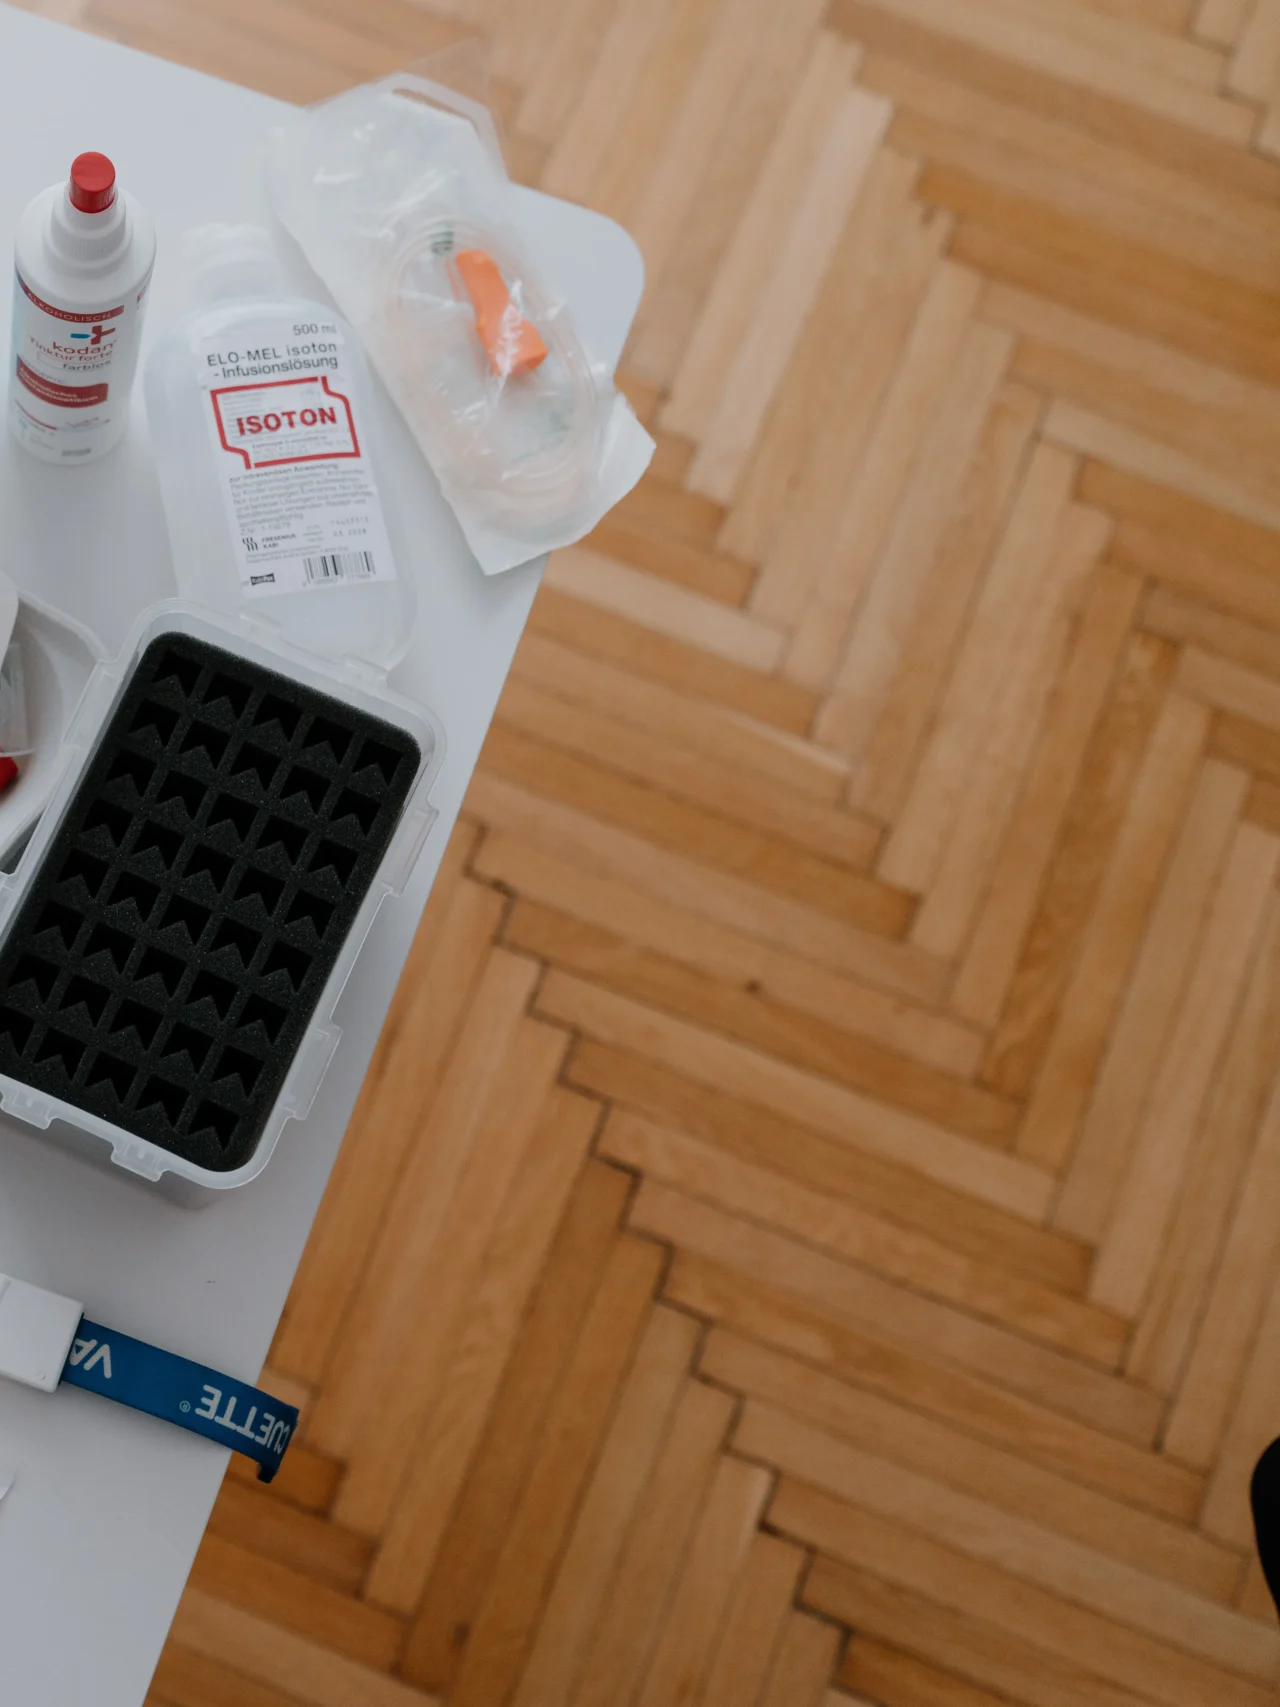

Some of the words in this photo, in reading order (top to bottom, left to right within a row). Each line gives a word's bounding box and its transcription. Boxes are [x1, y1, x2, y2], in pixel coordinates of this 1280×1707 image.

[27, 292, 112, 322] ALKOHOLISCH
[292, 323, 318, 336] 500
[29, 336, 73, 361] Tinktur
[79, 350, 113, 362] forte
[206, 347, 282, 367] ELO-MEL
[286, 342, 338, 357] isoton
[62, 360, 112, 371] farblos
[236, 406, 337, 436] ISOTON
